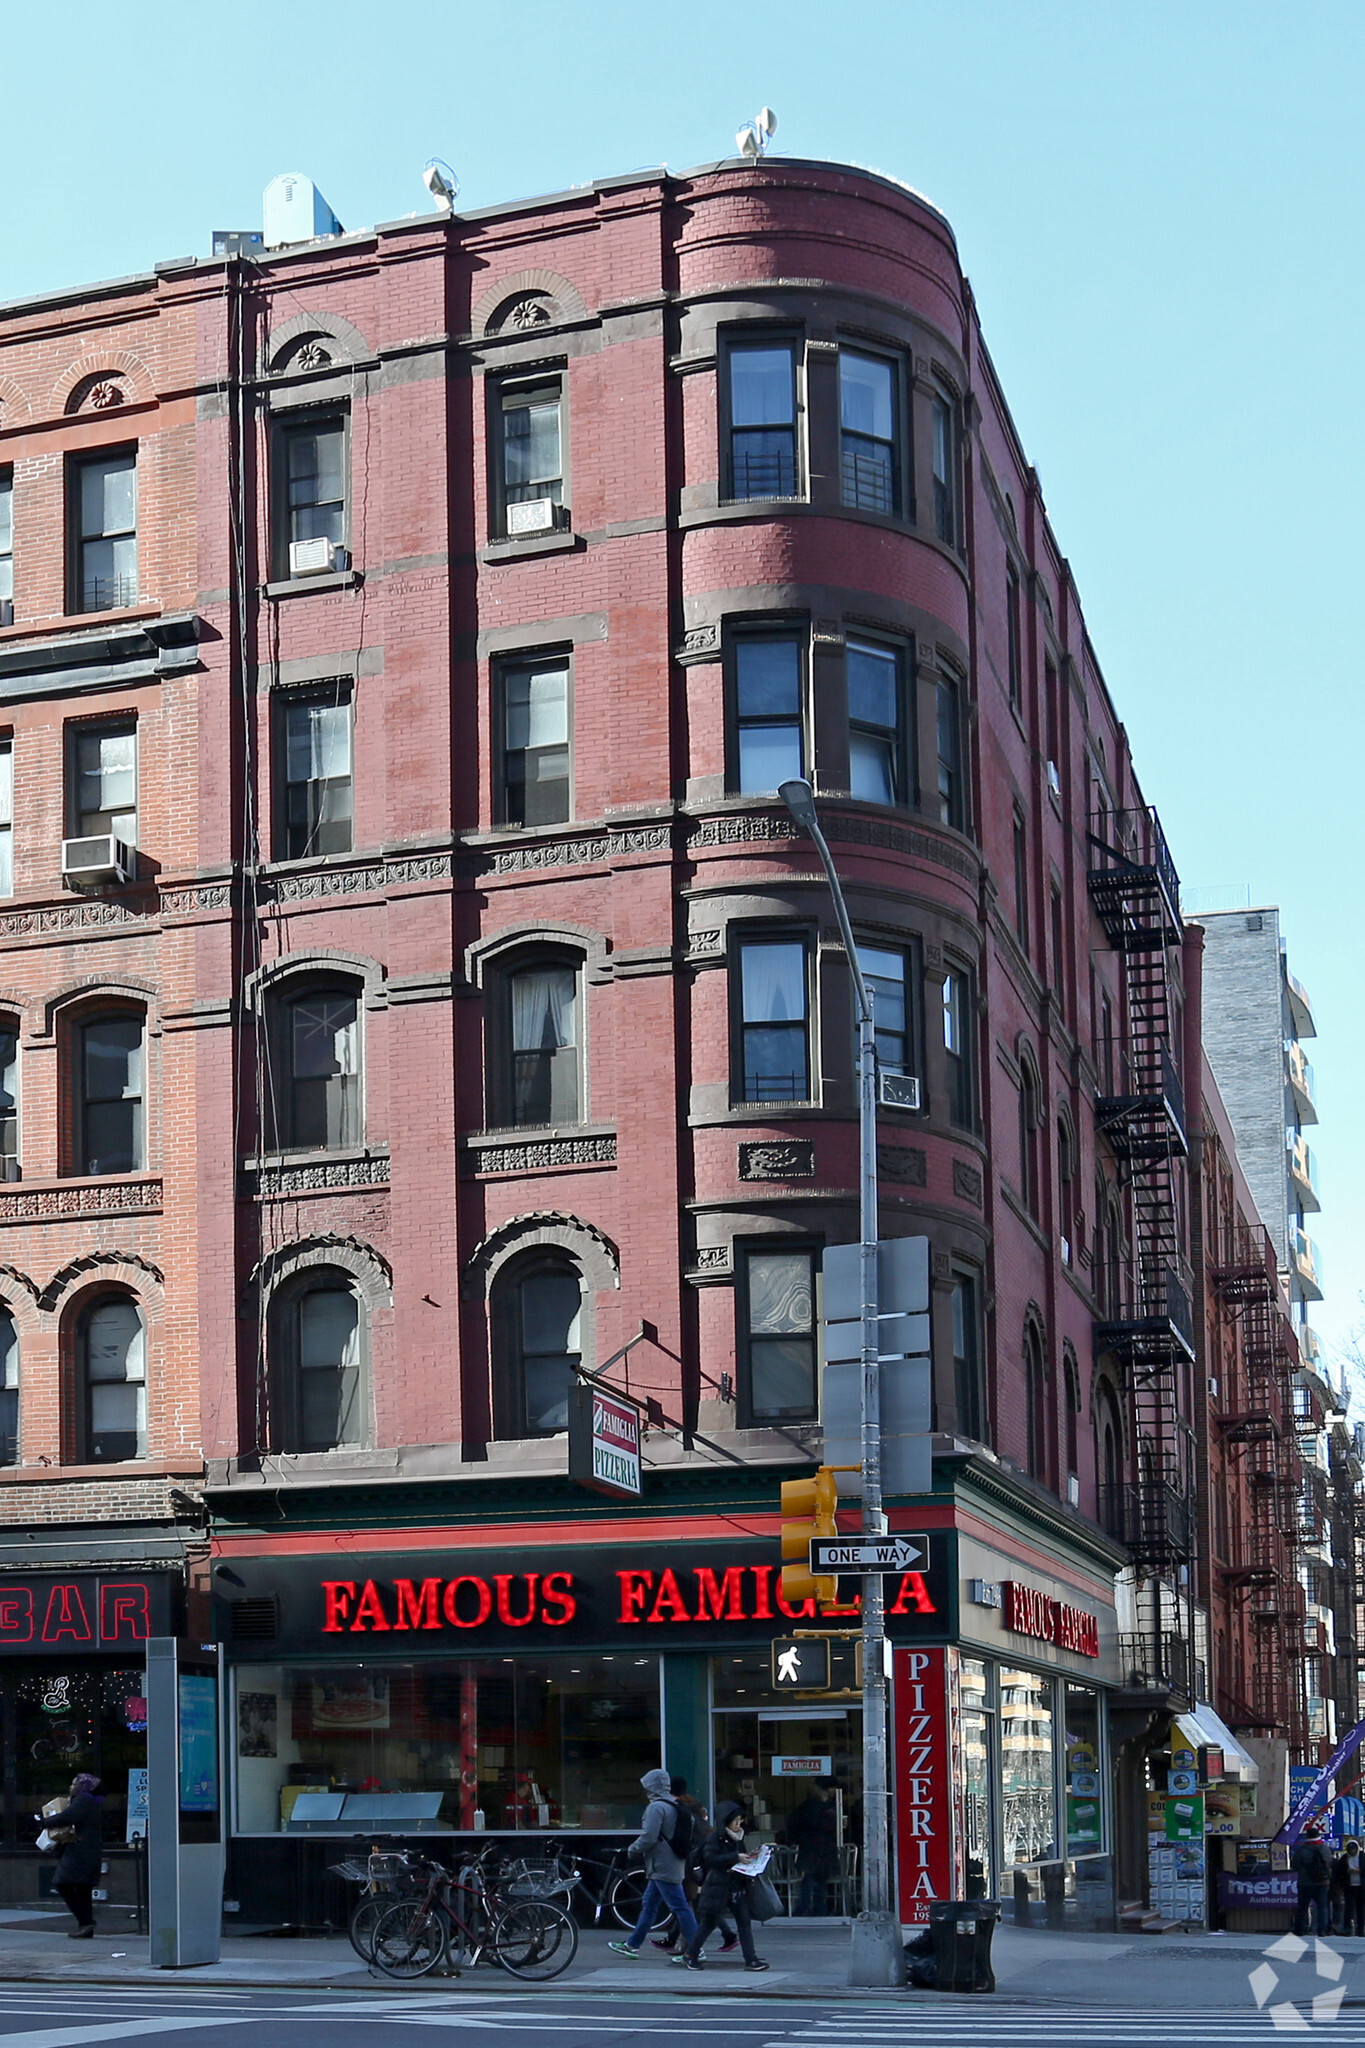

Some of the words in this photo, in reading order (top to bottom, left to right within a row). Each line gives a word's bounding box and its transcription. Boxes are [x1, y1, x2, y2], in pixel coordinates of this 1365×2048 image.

[602, 1410, 637, 1444] FAMIGLIA
[594, 1447, 639, 1489] PIZZERIA
[828, 1549, 861, 1562] ONE
[877, 1548, 911, 1561] WAY
[0, 1583, 151, 1643] BAR
[321, 1572, 577, 1632] FAMOUS
[615, 1565, 937, 1623] FAMIA
[1012, 1581, 1055, 1641] FAMOUS
[783, 1761, 820, 1769] FAMIGLIA
[907, 1653, 938, 1899] PIZZERIA
[913, 1912, 930, 1921] 198
[1249, 1896, 1298, 1904] Authorized
